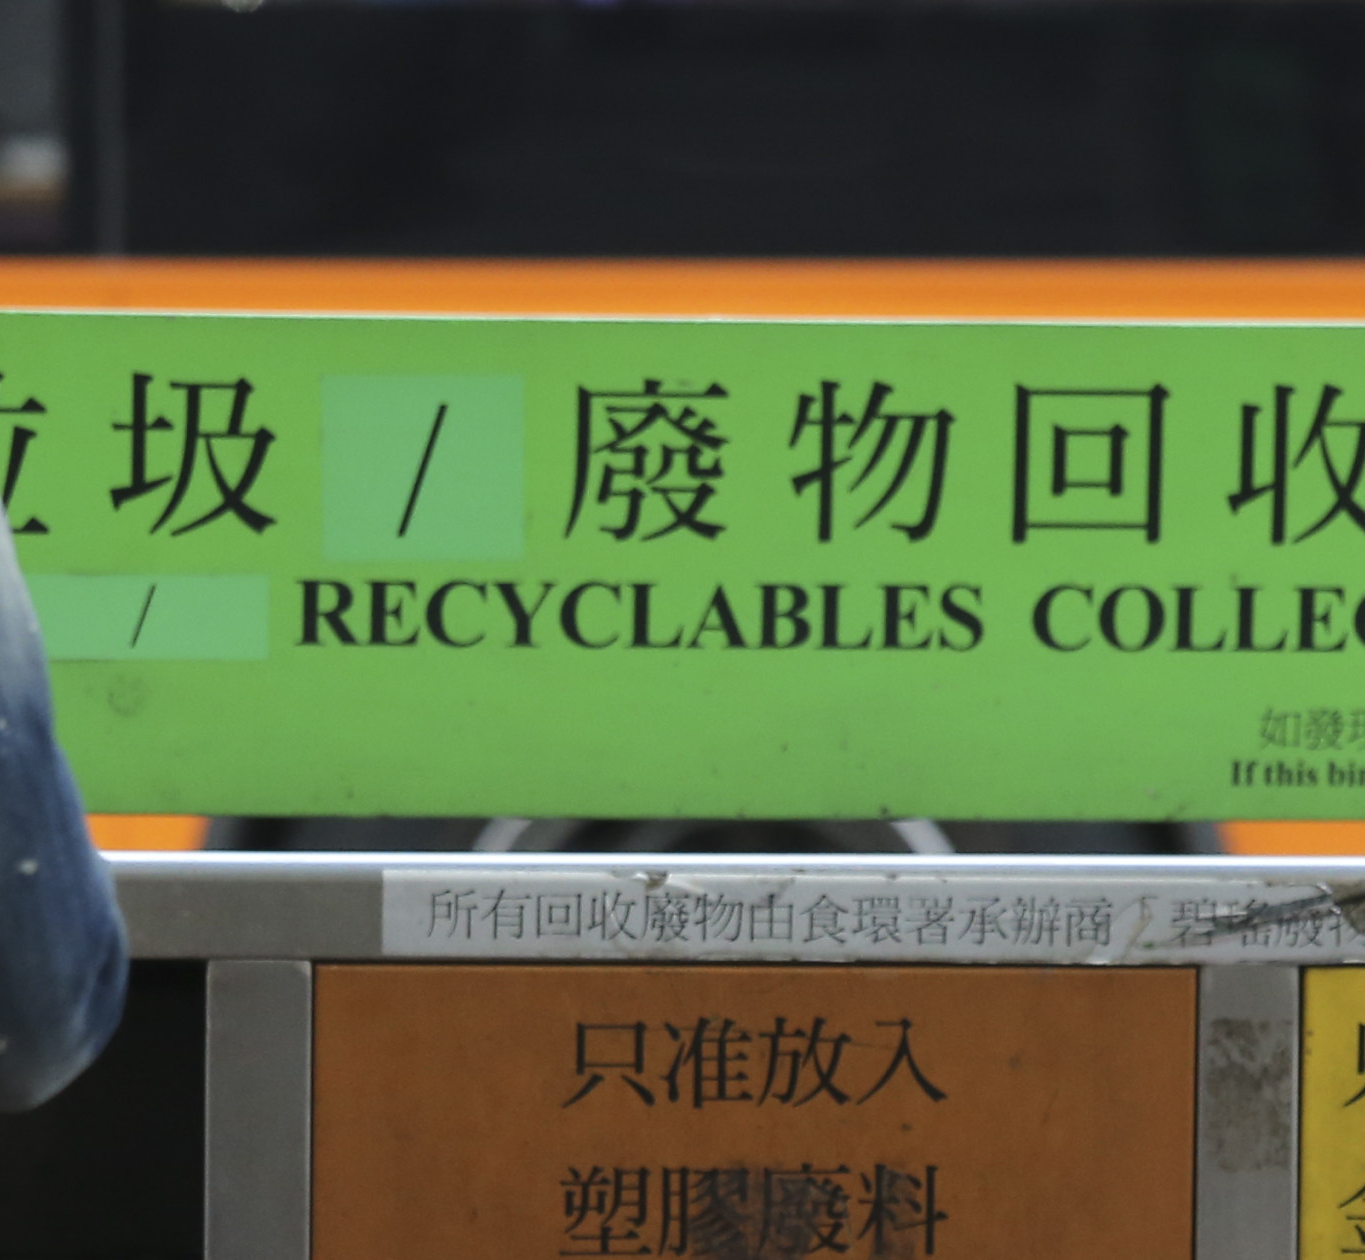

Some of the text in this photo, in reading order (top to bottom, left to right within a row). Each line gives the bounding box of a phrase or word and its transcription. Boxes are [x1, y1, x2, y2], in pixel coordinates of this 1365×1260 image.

[296, 578, 985, 653] RECYCLABLES
[1230, 759, 1259, 790] If
[1264, 759, 1318, 790] this
[561, 1015, 948, 1109] 只准放入
[557, 1162, 948, 1258] 塑膠廢料
